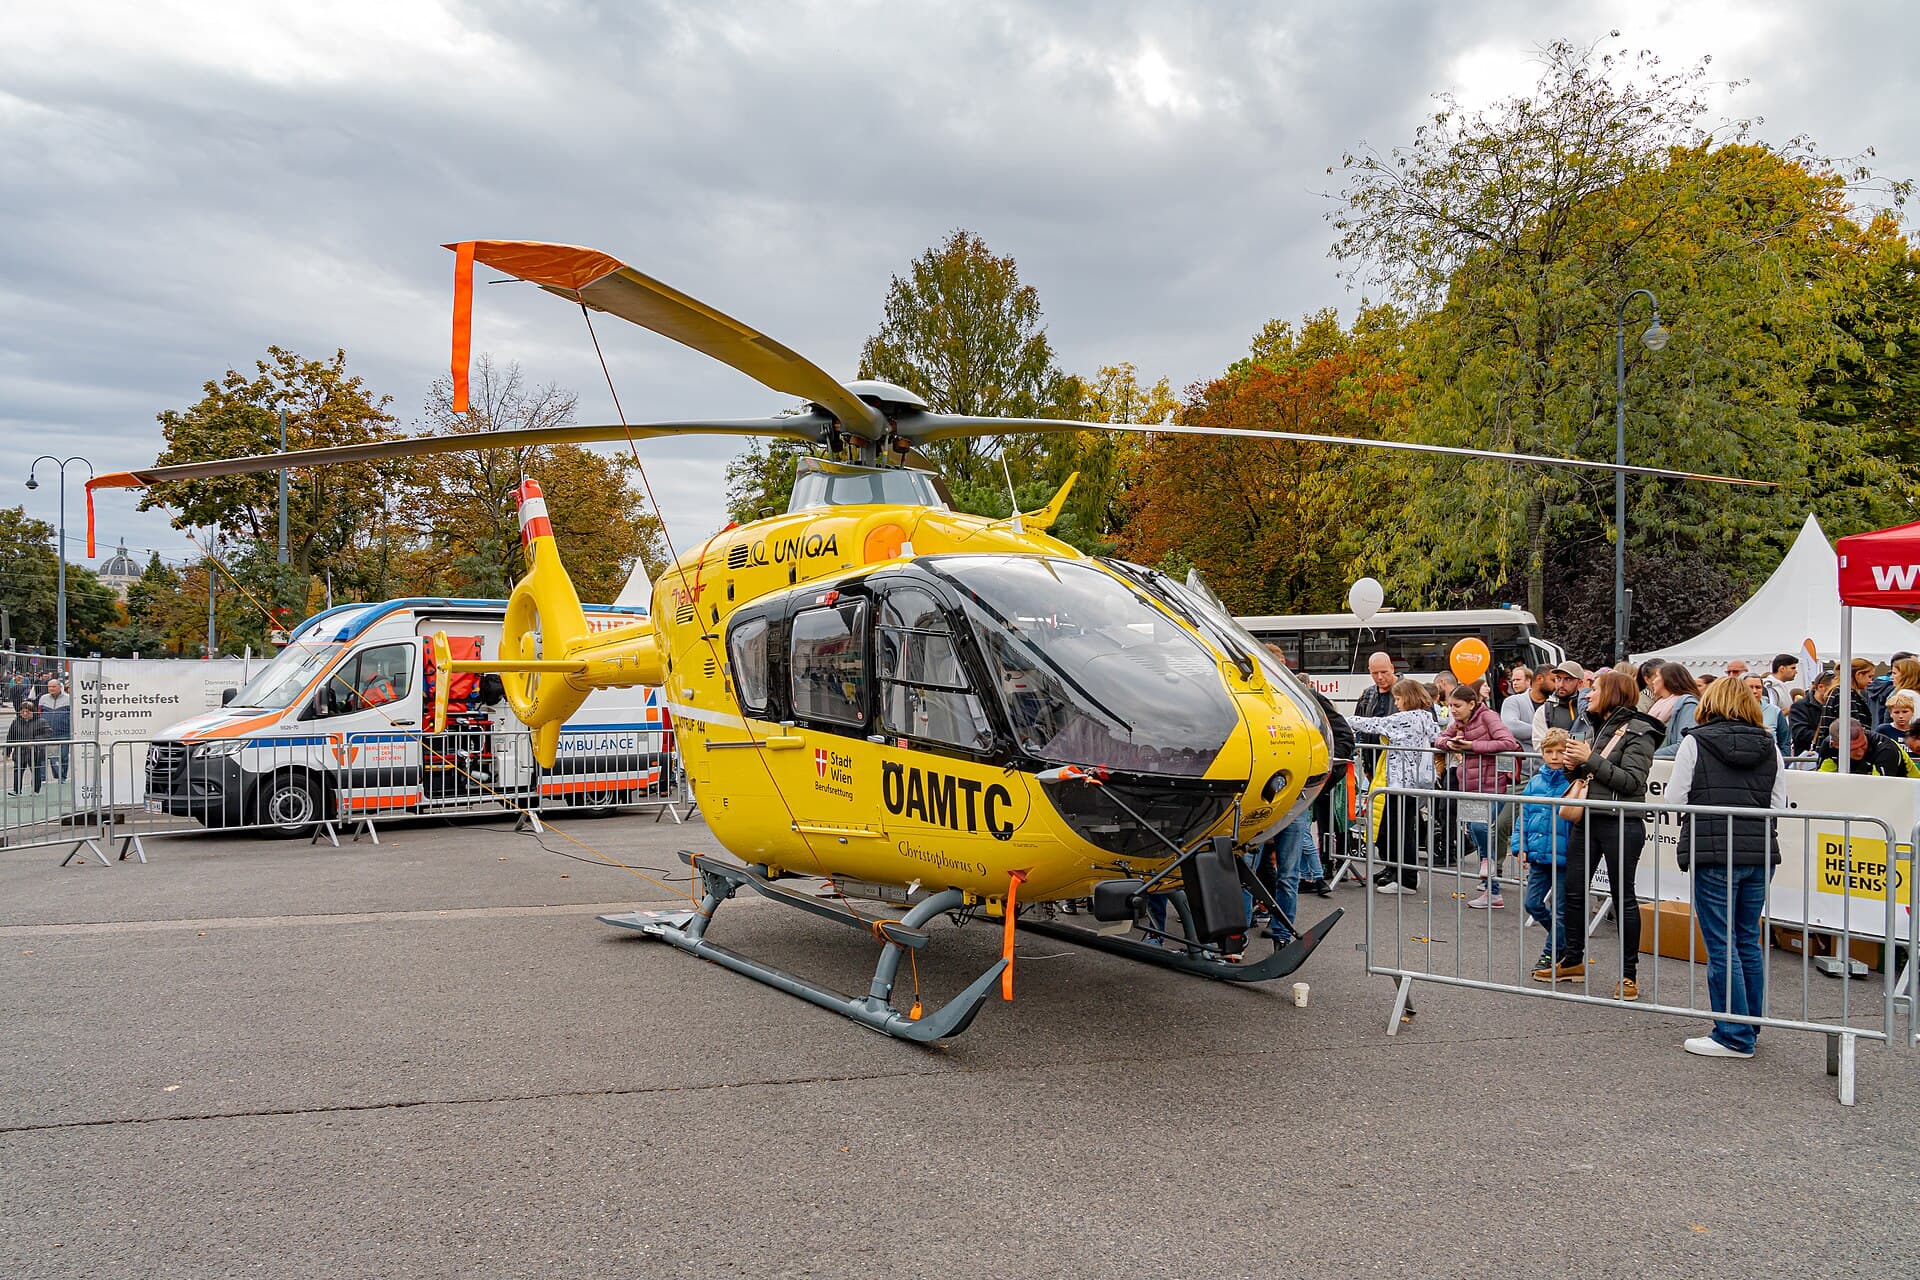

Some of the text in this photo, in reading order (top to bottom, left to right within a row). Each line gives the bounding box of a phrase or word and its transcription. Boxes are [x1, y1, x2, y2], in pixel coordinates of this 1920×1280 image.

[774, 533, 838, 564] UNIQA
[1871, 564, 1920, 591] W
[80, 680, 130, 691] Wiener
[1311, 680, 1339, 693] lut!
[80, 694, 180, 705] Sicherheitsfest
[81, 709, 153, 721] Programm
[557, 738, 634, 752] AMBULANCE
[830, 751, 852, 769] Stadt
[830, 767, 853, 785] Wien
[815, 780, 853, 801] Berufsrettung
[723, 798, 729, 807] E
[882, 759, 1014, 841] ÖAMTC
[898, 840, 973, 873] Christophorus
